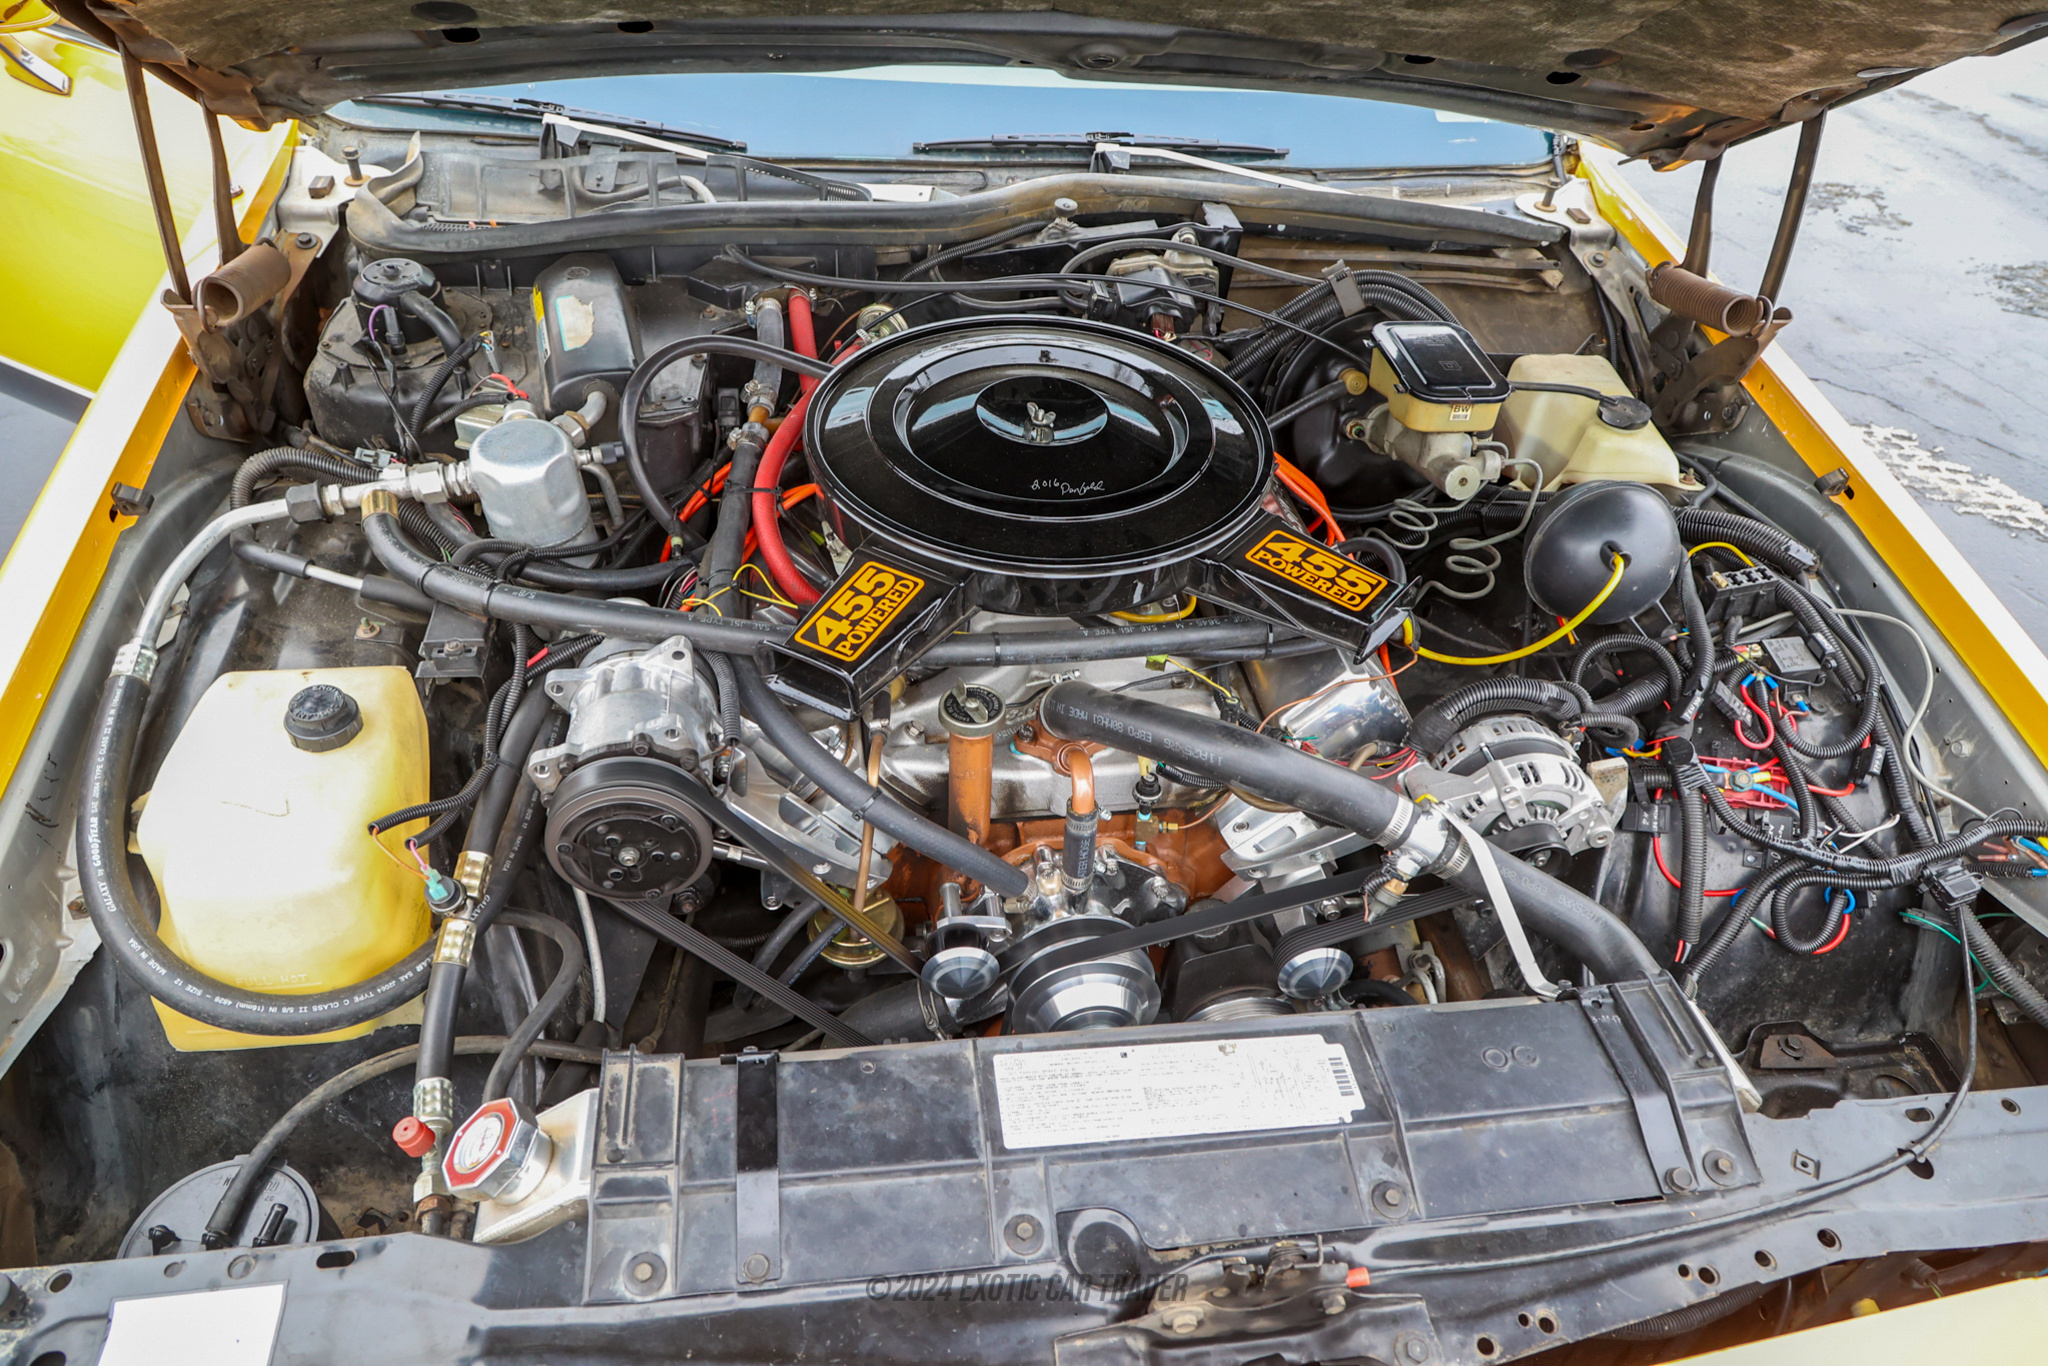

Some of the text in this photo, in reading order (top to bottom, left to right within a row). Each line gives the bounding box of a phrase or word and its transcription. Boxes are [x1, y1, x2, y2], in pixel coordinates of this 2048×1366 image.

[1453, 405, 1471, 413] BW
[1031, 478, 1060, 491] 2016
[1265, 541, 1379, 595] 455
[1252, 549, 1362, 606] POWERED
[816, 567, 896, 647] 455
[835, 579, 915, 656] POWERED
[1094, 627, 1117, 636] TYPE
[1069, 705, 1088, 721] MADE
[99, 733, 110, 756] CLASS
[94, 763, 104, 780] TYPE
[91, 801, 99, 814] SAE
[88, 816, 101, 868] GOODYEAR
[513, 835, 523, 850] MADE
[1079, 838, 1091, 860] HOSE
[502, 860, 512, 872] USA
[97, 881, 117, 913] GALAXY
[128, 937, 141, 951] USA
[140, 950, 149, 960] IN
[147, 958, 167, 975] MADE
[173, 977, 184, 986] 12
[234, 973, 308, 987] FULL HOT
[398, 970, 414, 982] SAE
[184, 983, 203, 996] SIZE
[352, 990, 375, 1002] TYPE
[235, 1001, 264, 1012] (16mm)
[311, 1001, 340, 1012] CLASS
[342, 998, 350, 1006] C
[281, 1006, 294, 1014] 5/8
